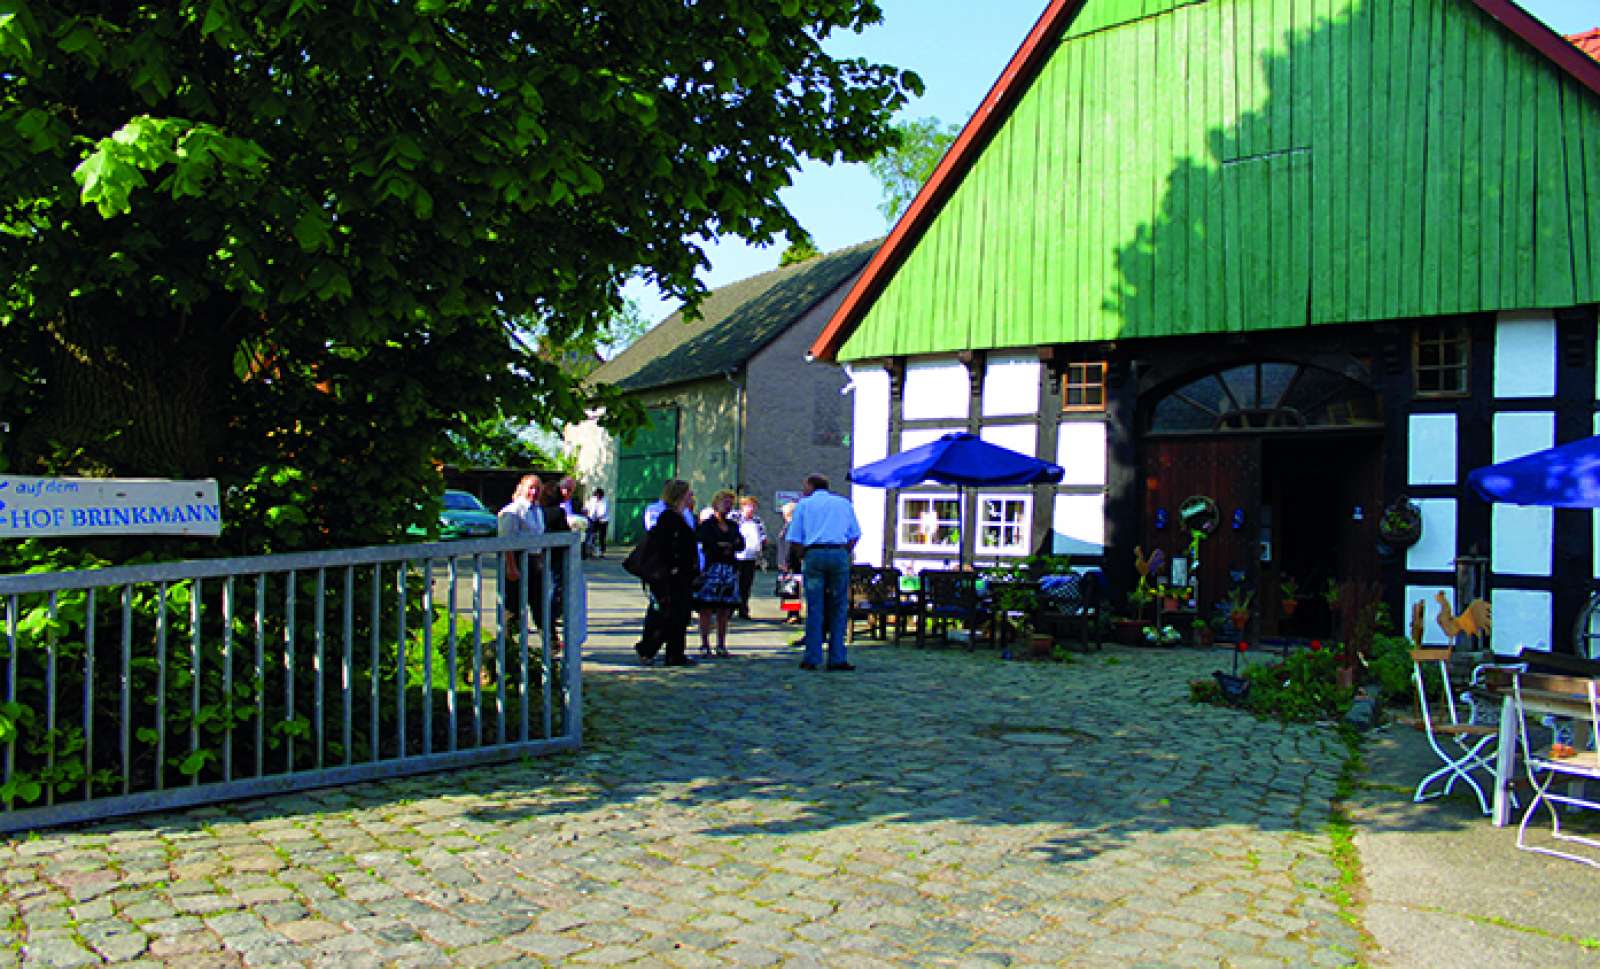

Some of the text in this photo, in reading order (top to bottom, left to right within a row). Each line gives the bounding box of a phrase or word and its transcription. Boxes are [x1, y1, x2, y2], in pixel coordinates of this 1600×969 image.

[16, 480, 79, 497] auf dem
[11, 504, 219, 528] HOF BRINKMANN
